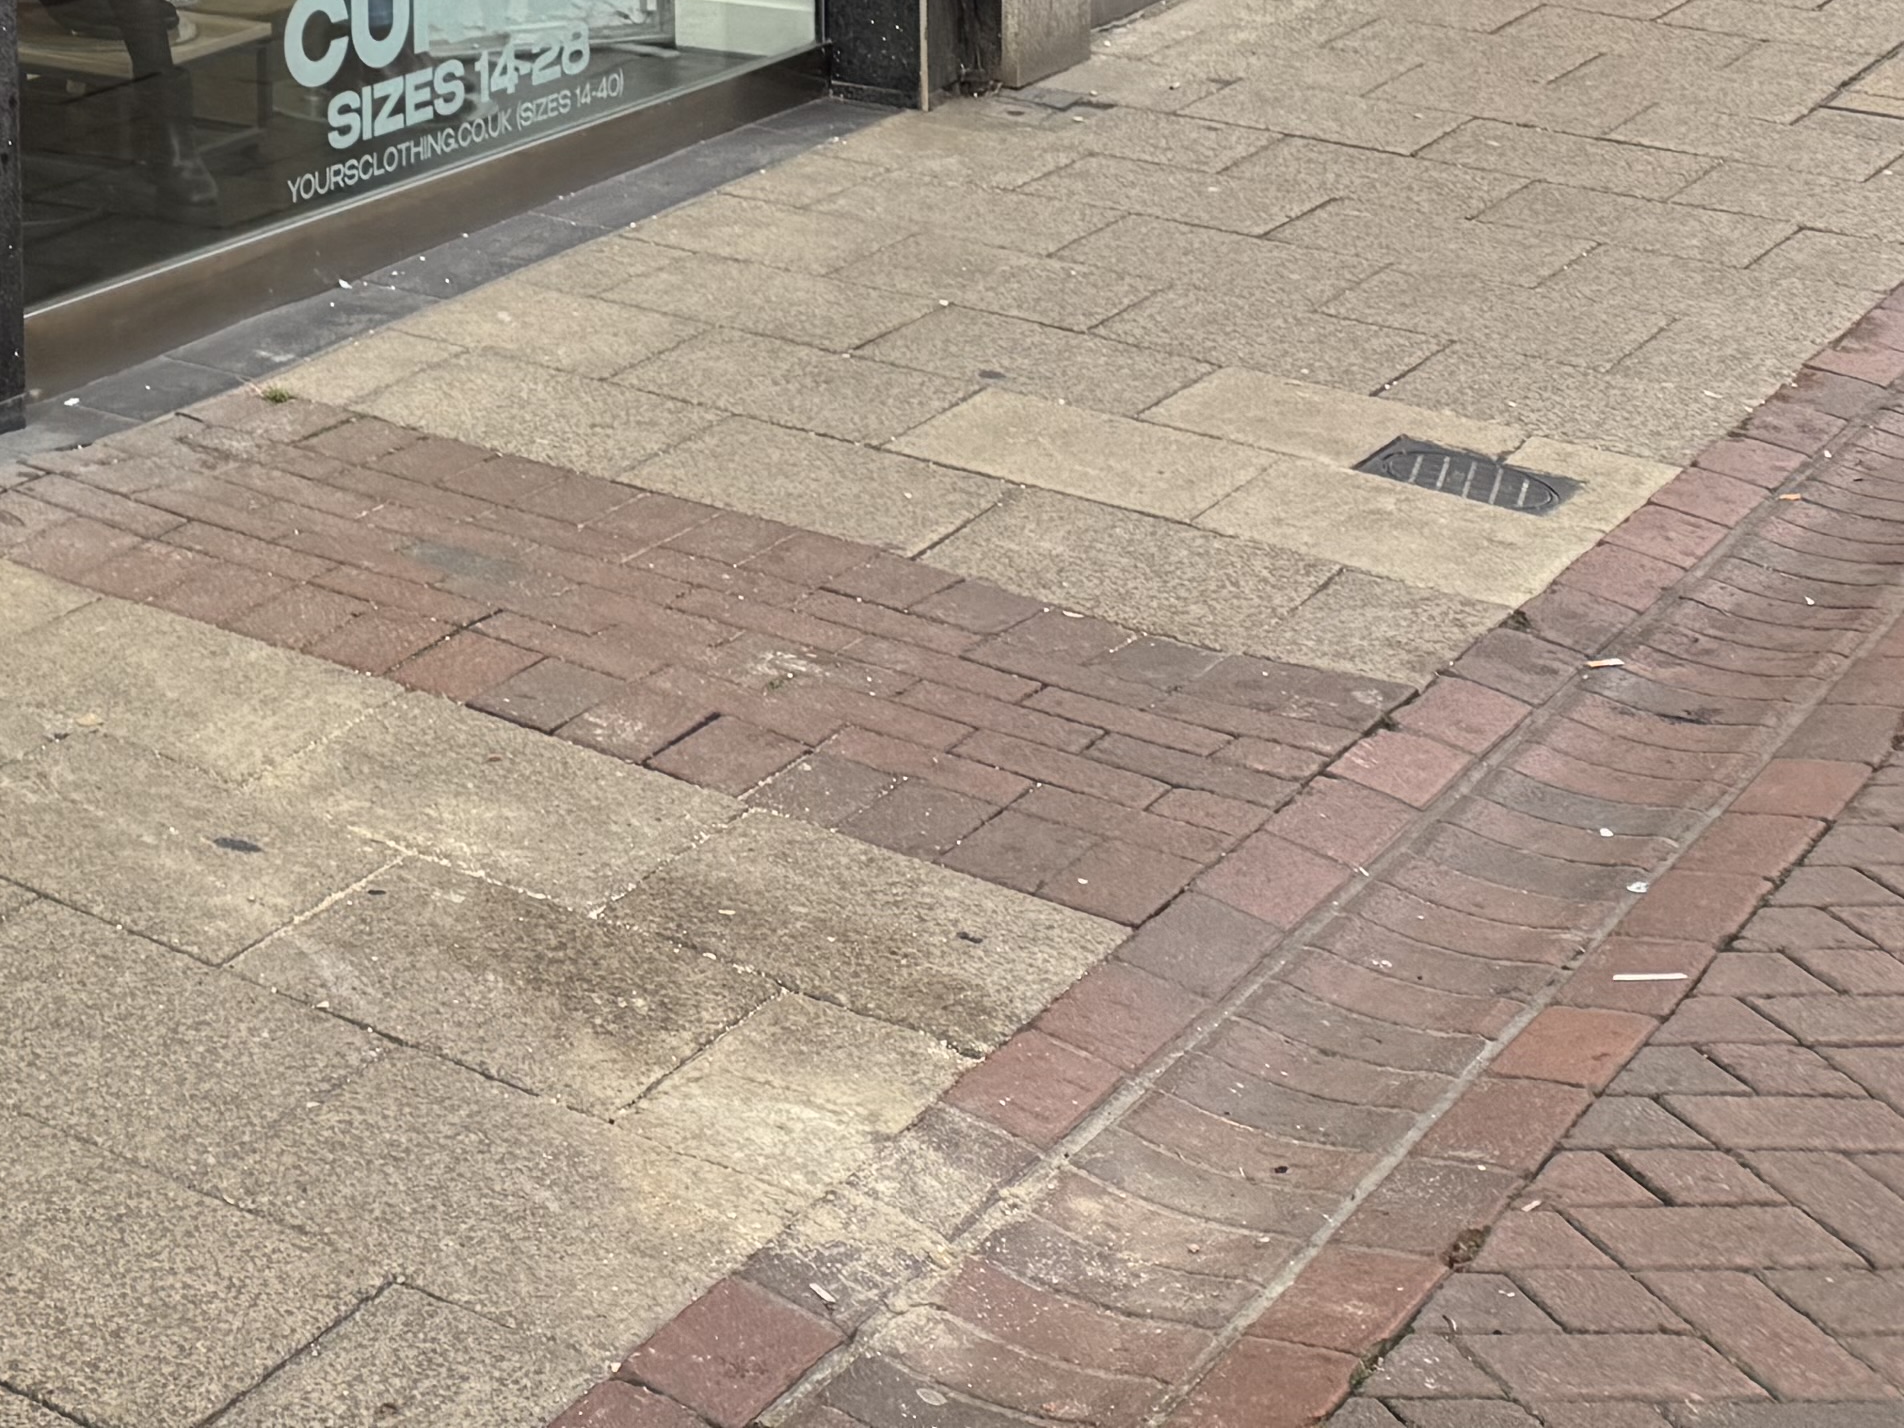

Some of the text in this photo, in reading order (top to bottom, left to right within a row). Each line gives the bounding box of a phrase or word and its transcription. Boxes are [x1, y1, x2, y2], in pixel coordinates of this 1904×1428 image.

[287, 68, 625, 203] YOURSCLOTHING.CO.UK (SIZES 14-40)
[327, 20, 591, 149] SIZES 14-28
